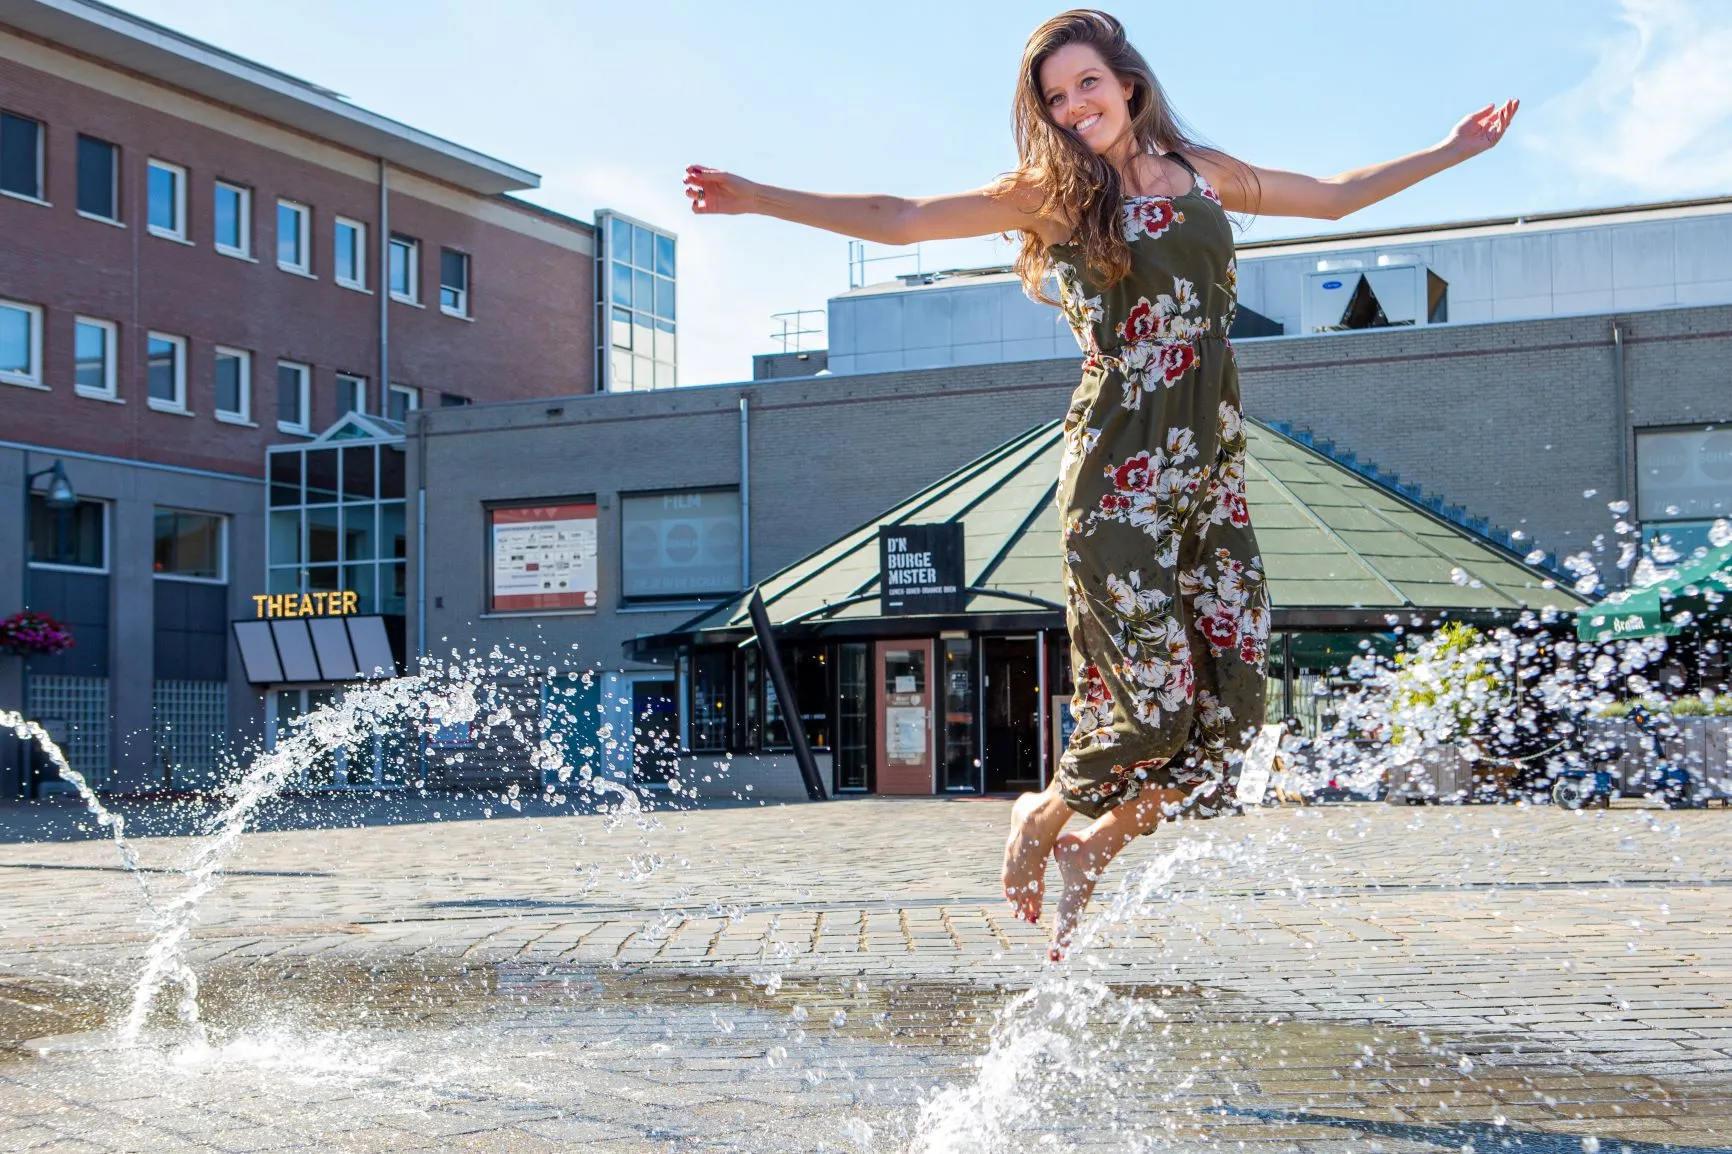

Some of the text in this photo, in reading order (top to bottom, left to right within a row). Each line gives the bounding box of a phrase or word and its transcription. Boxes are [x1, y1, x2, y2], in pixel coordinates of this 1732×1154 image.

[663, 493, 702, 510] FILM
[887, 537, 907, 552] D'N
[888, 552, 931, 568] BURGE
[888, 568, 936, 584] MISTER
[252, 590, 359, 618] THEATER
